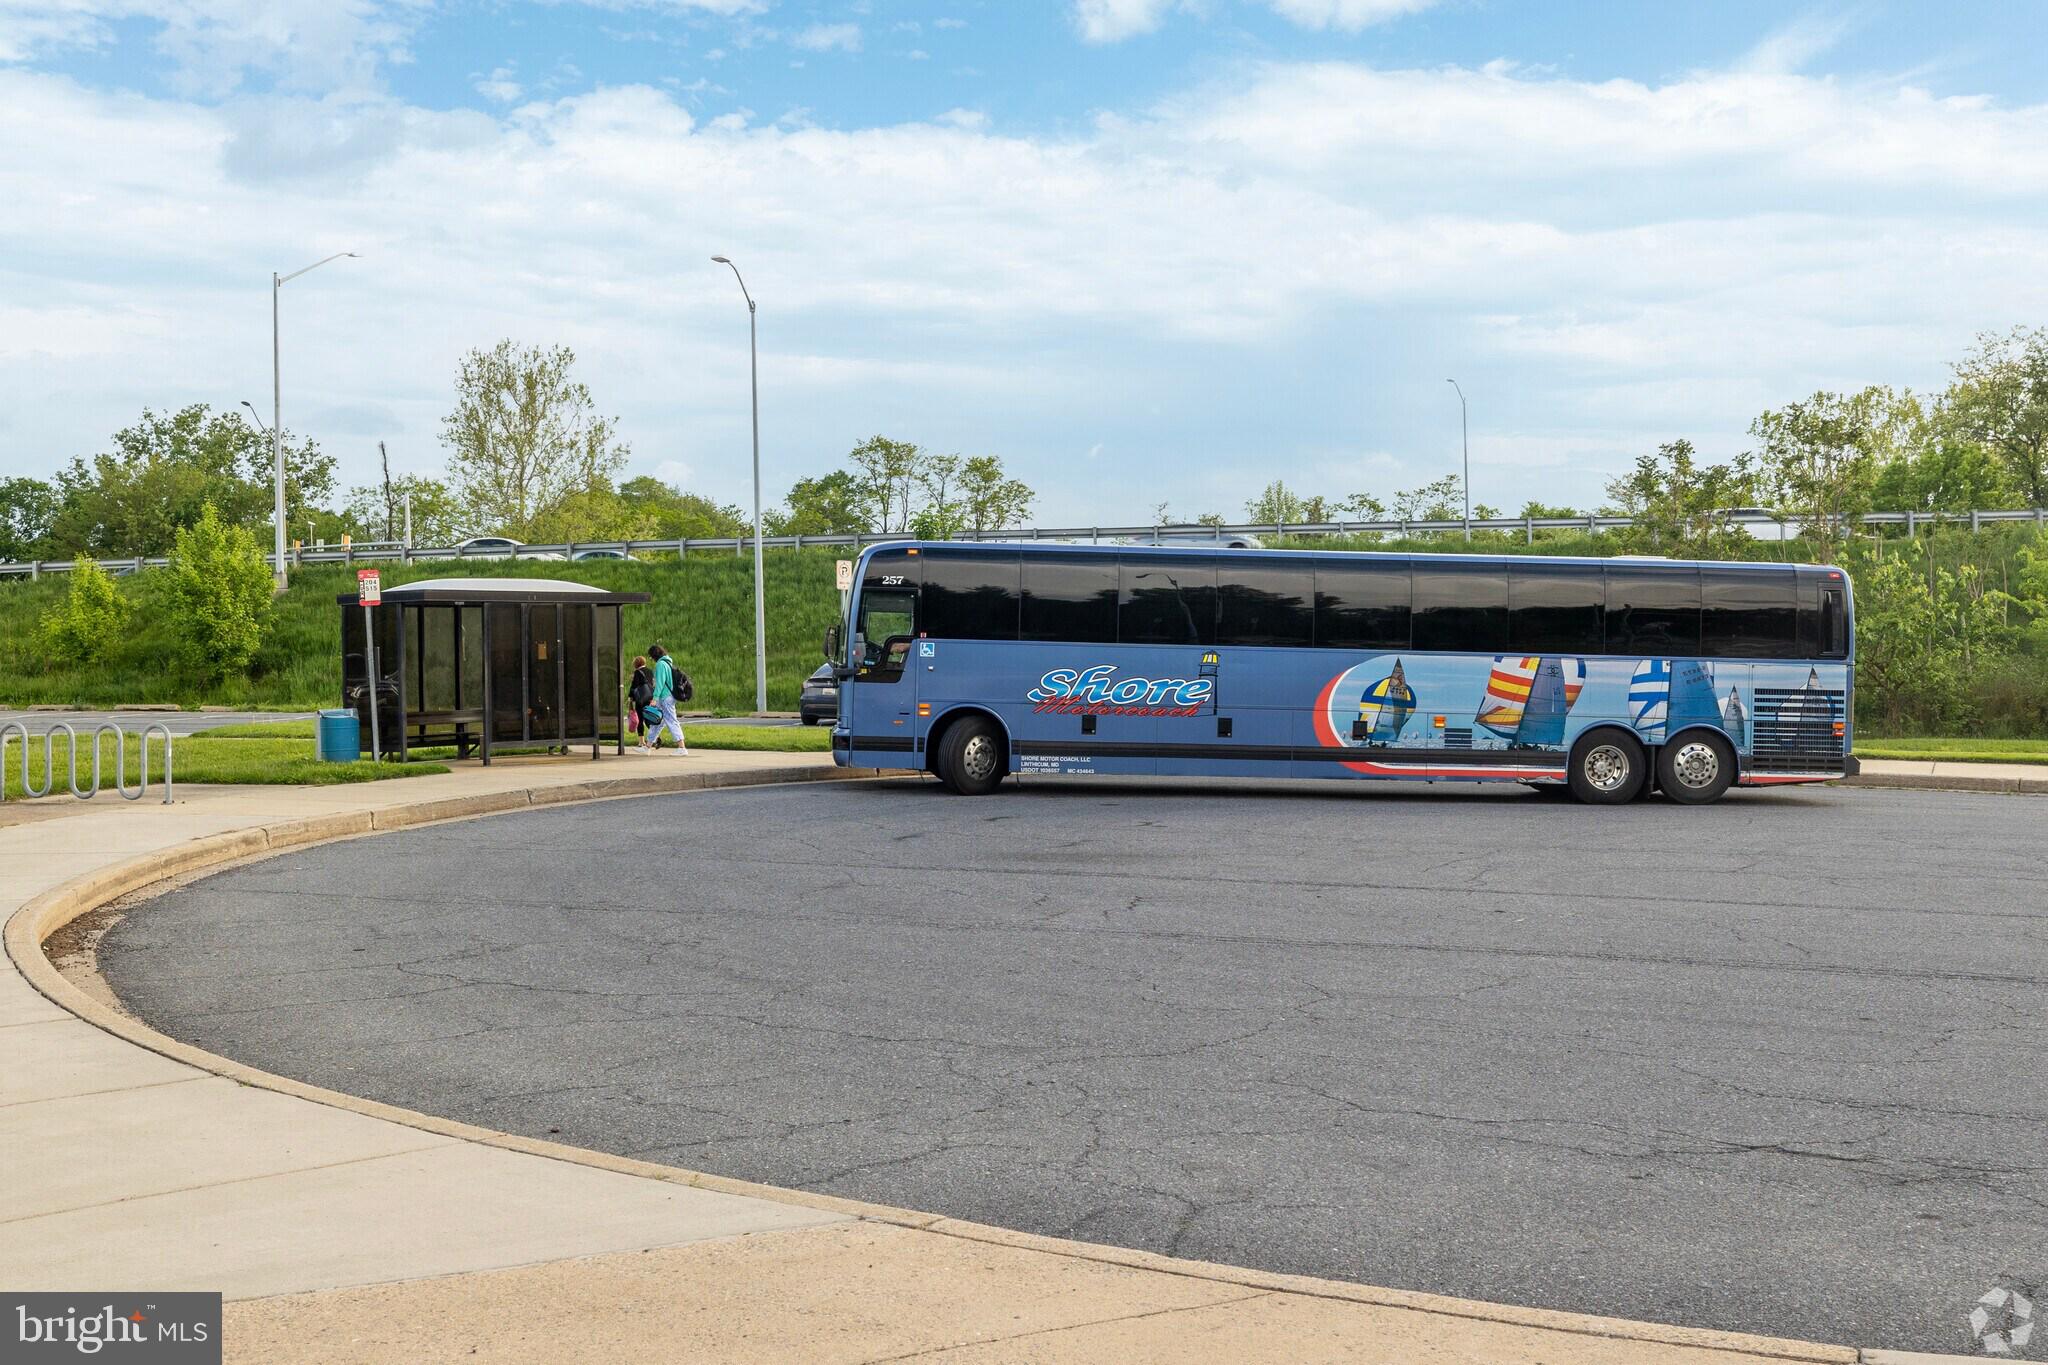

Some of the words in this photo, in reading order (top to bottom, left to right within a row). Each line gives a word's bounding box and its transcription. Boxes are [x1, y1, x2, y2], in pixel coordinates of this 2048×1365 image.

[882, 576, 904, 585] 257
[1027, 665, 1212, 706] Shore
[1032, 695, 1205, 716] Motorcoach
